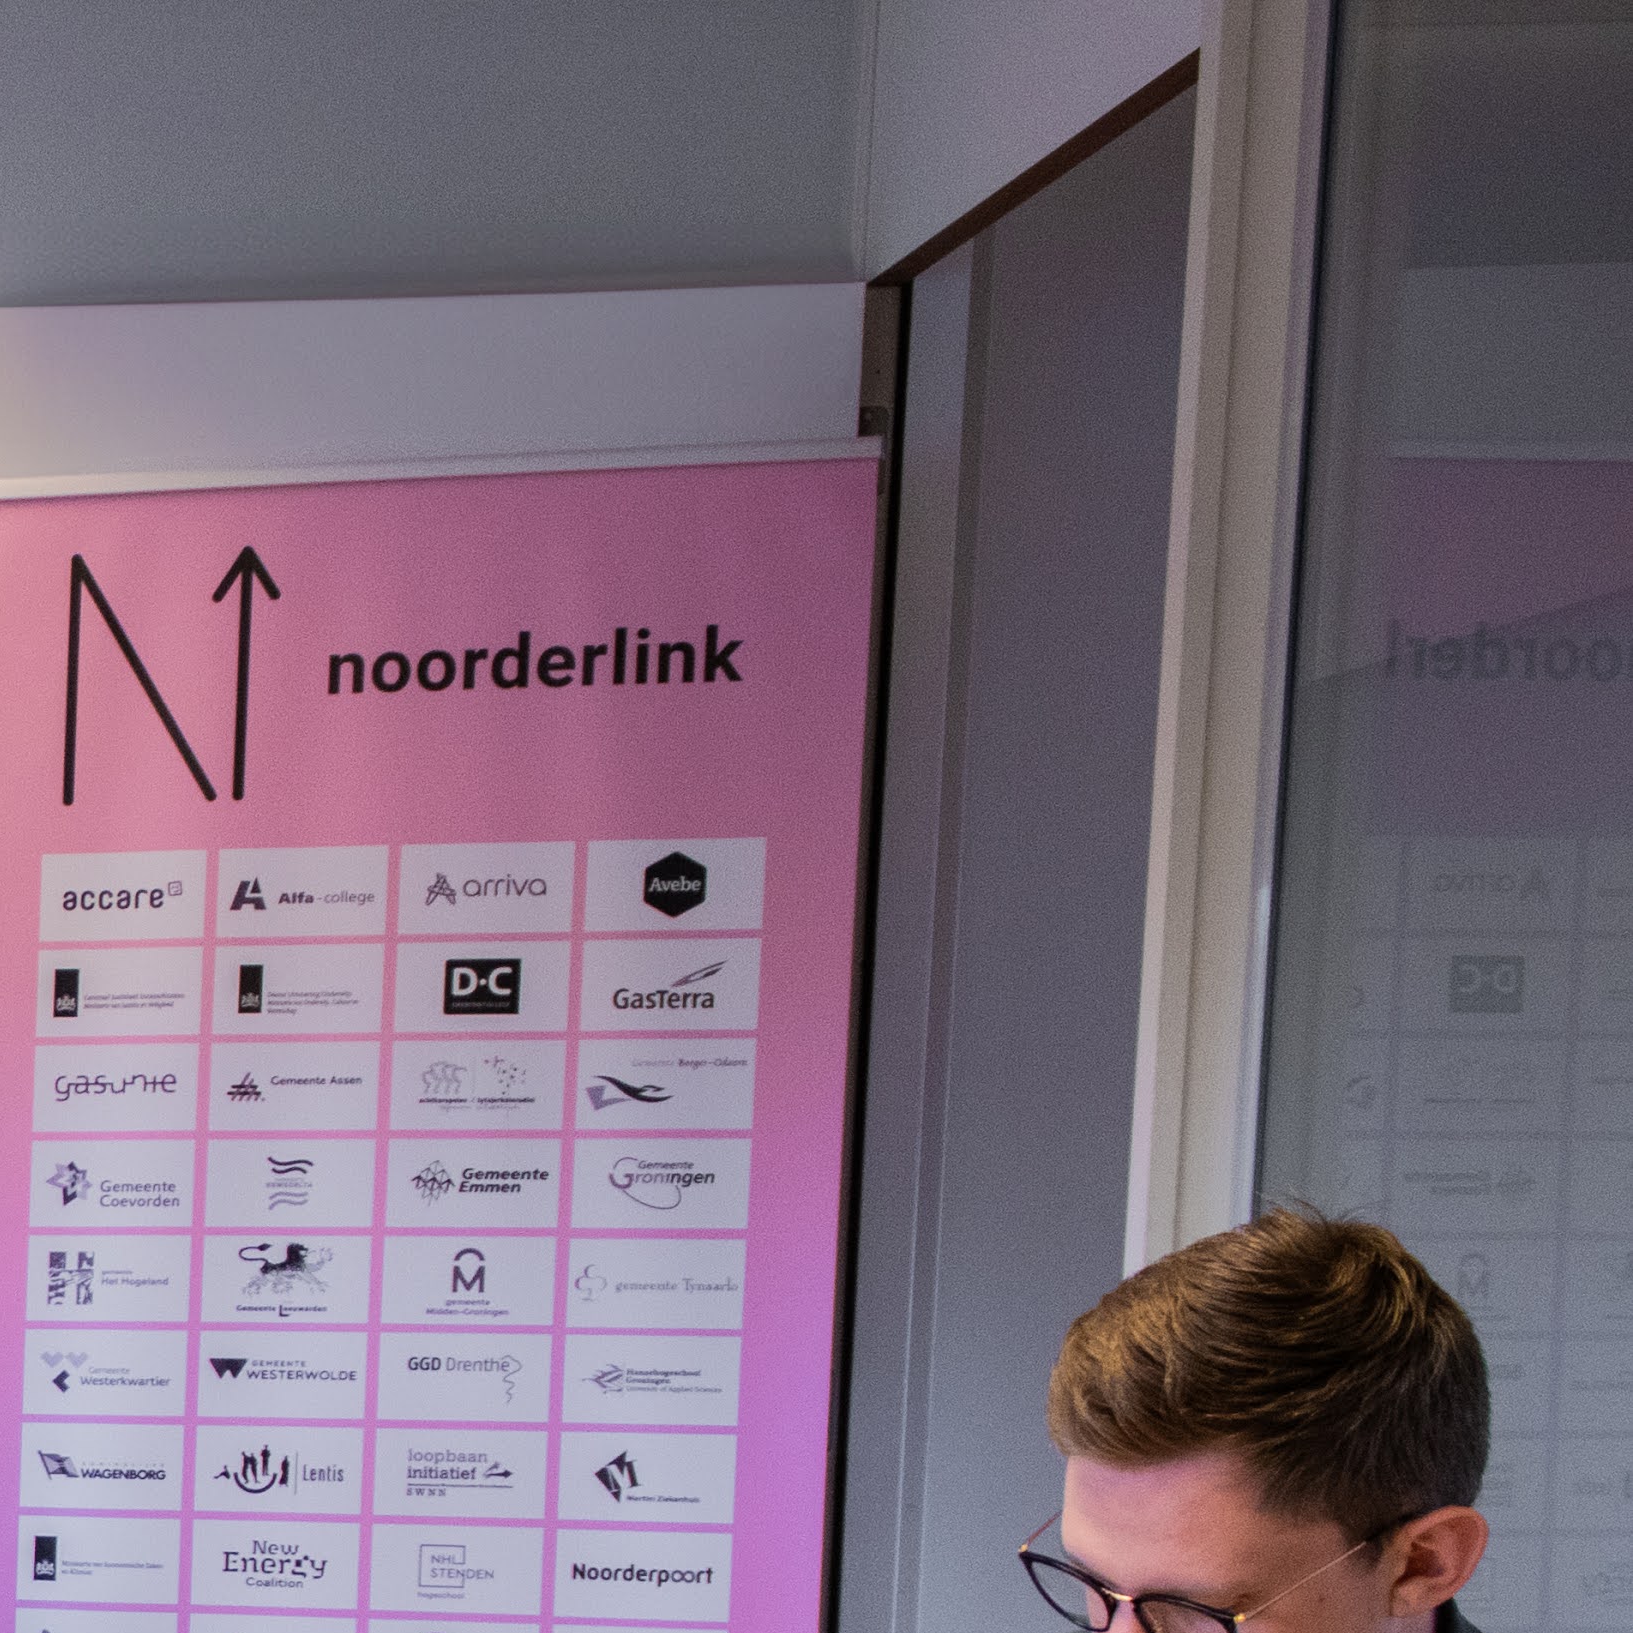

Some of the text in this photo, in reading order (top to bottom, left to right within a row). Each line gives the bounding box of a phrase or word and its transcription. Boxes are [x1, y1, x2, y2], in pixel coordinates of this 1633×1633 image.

[328, 625, 744, 695] noorderlink
[462, 873, 548, 897] arriva
[649, 876, 702, 893] Avebe
[62, 888, 165, 912] accare
[612, 988, 715, 1010] GasTerra
[270, 1075, 363, 1086] Gemeente Assen
[637, 1159, 695, 1170] Gemeente
[461, 1167, 550, 1182] Gemeente
[100, 1180, 177, 1194] Gemeente
[458, 1181, 522, 1194] Emmen
[100, 1195, 181, 1209] Coevorden
[615, 1281, 678, 1293] gemeente
[407, 1357, 511, 1373] GGD Drenthe
[80, 1375, 171, 1388] Westerkwartier
[246, 1369, 359, 1382] WESTERWOLDE
[407, 1449, 488, 1467] loopbaan
[81, 1467, 167, 1481] WAGENBORG
[302, 1464, 345, 1483] Lentis
[406, 1466, 477, 1480] initiatief
[252, 1539, 300, 1556] New
[222, 1550, 328, 1580] Energy
[429, 1567, 495, 1581] STENDEN
[571, 1563, 714, 1587] Noorderpoort
[246, 1576, 304, 1589] Coalition
